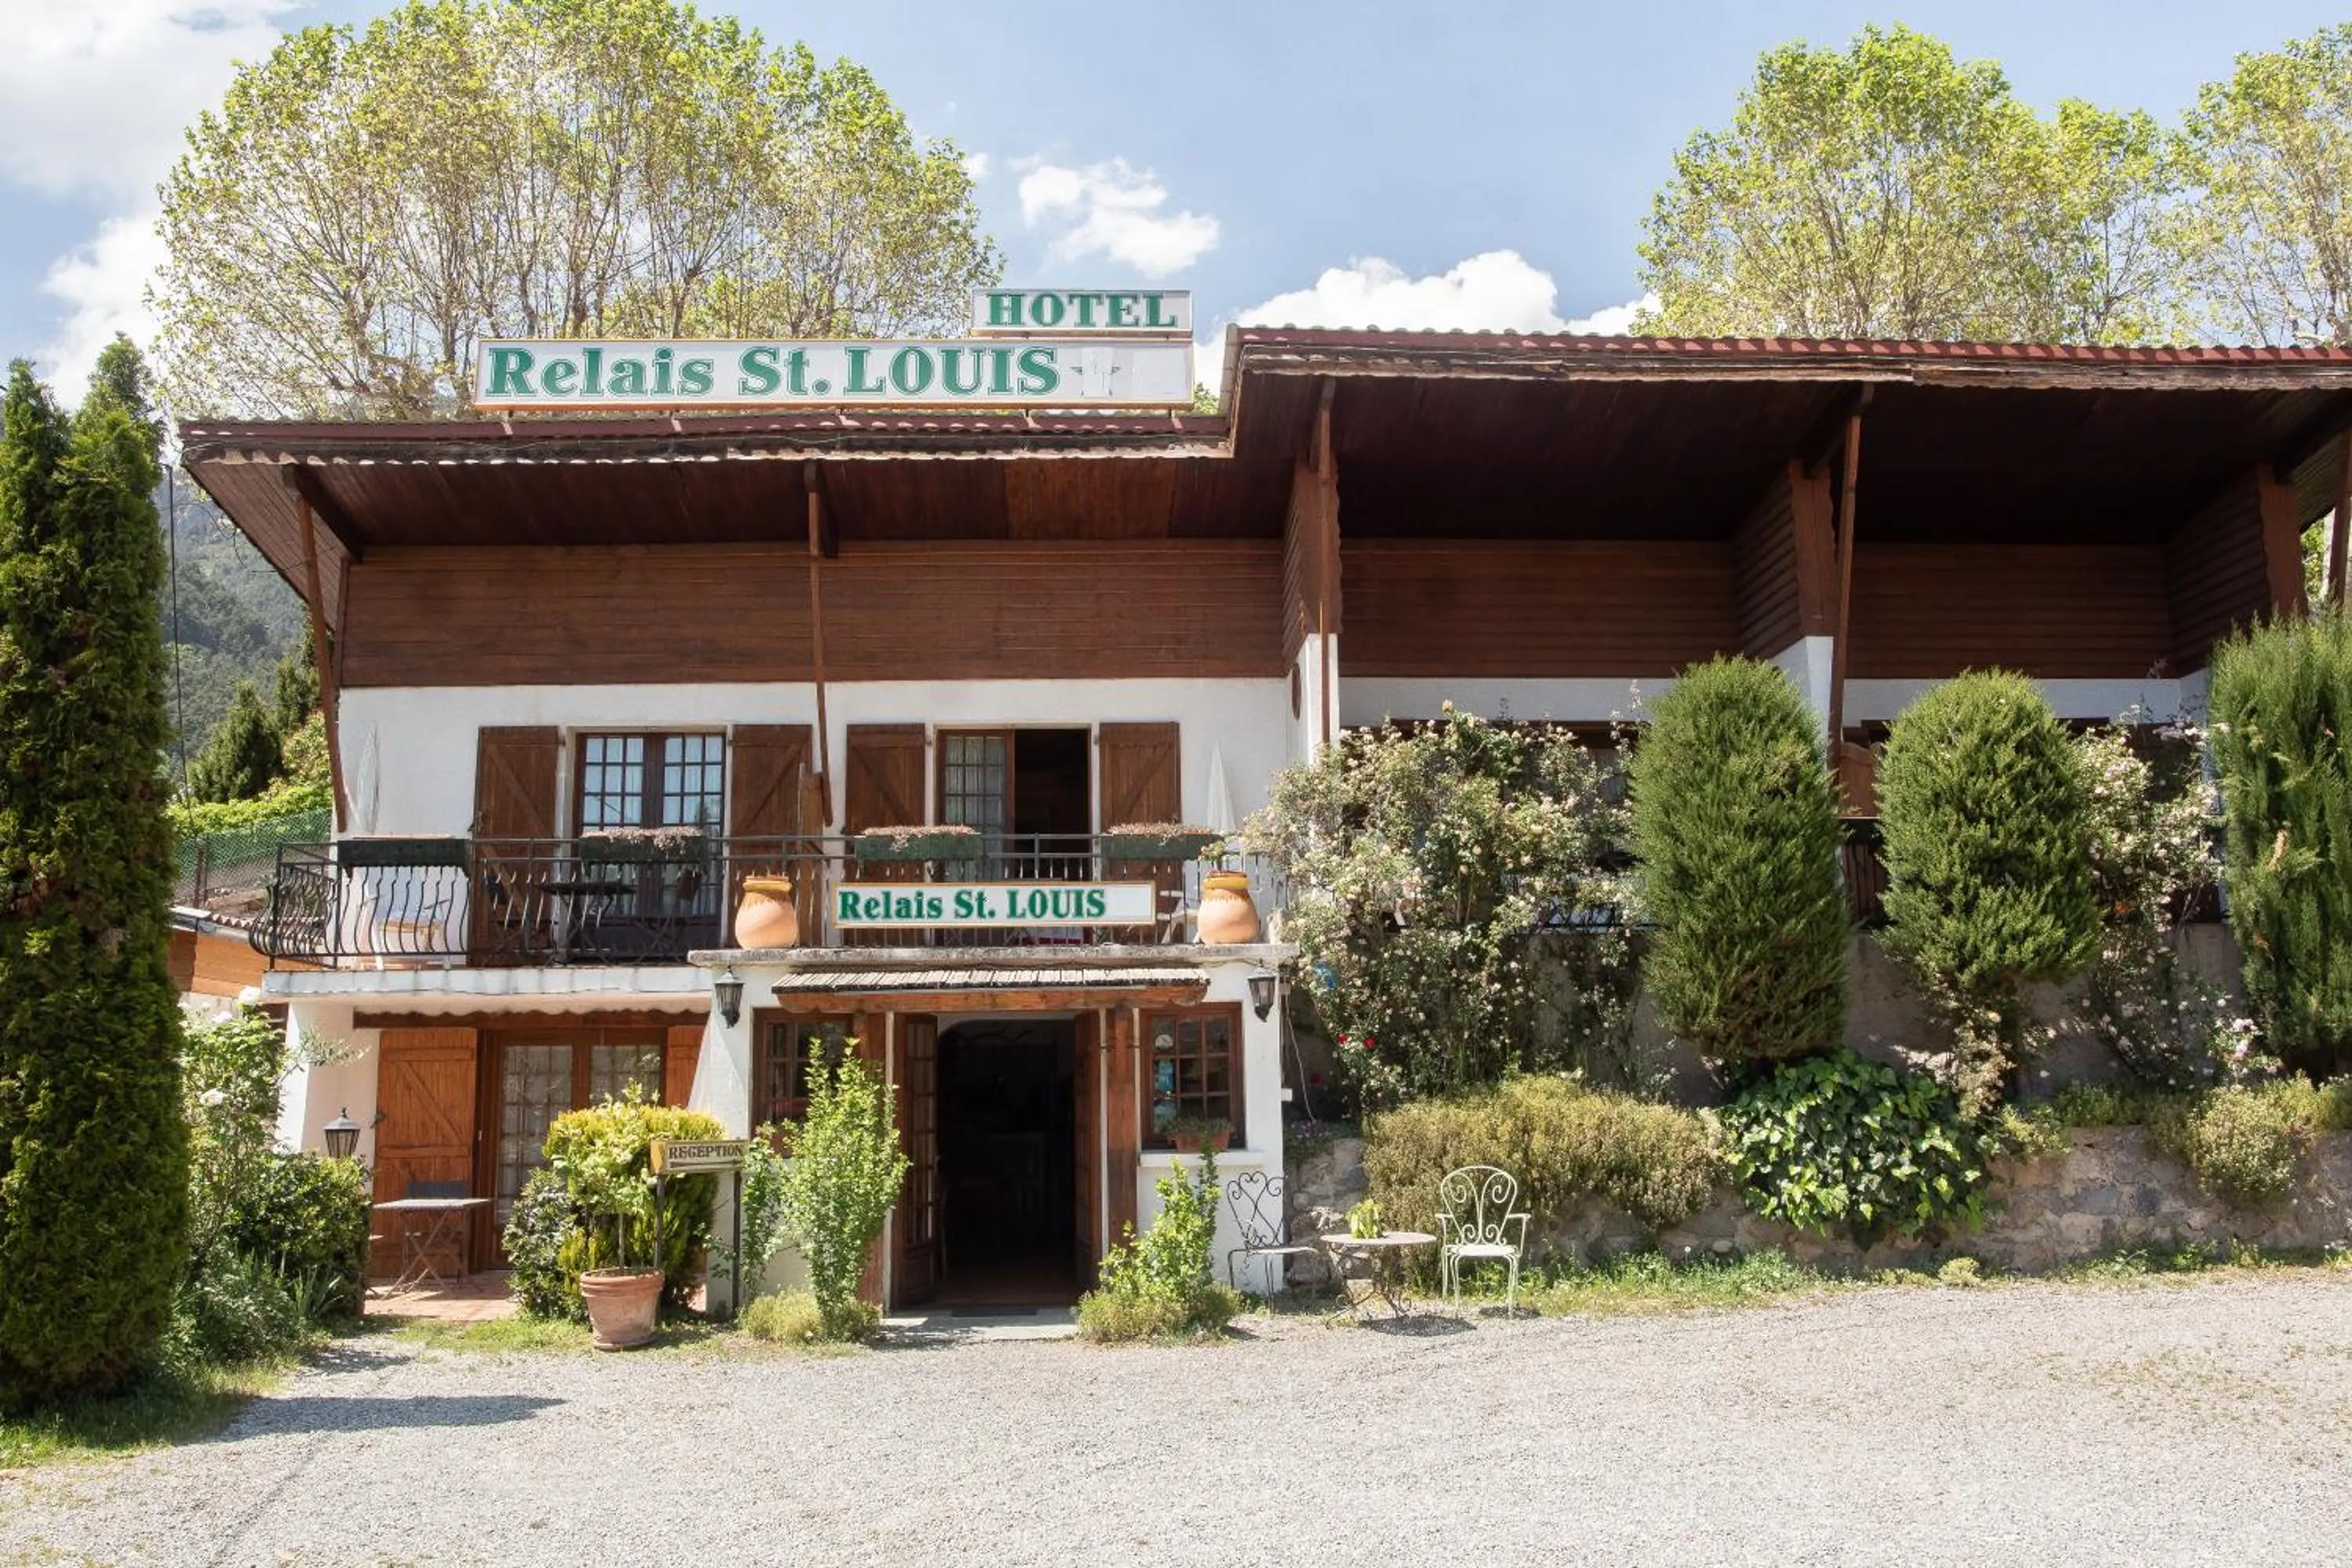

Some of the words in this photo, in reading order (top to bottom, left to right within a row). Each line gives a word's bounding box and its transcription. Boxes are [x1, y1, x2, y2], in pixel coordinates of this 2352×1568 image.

[986, 292, 1177, 327] HOTEL
[485, 347, 715, 397] Relais
[738, 346, 832, 396] St.
[843, 345, 1061, 396] LOUIS
[838, 890, 943, 920] Relais
[953, 889, 996, 920] St.
[1006, 888, 1106, 919] LOUIS
[669, 1145, 743, 1159] RECEPTION
